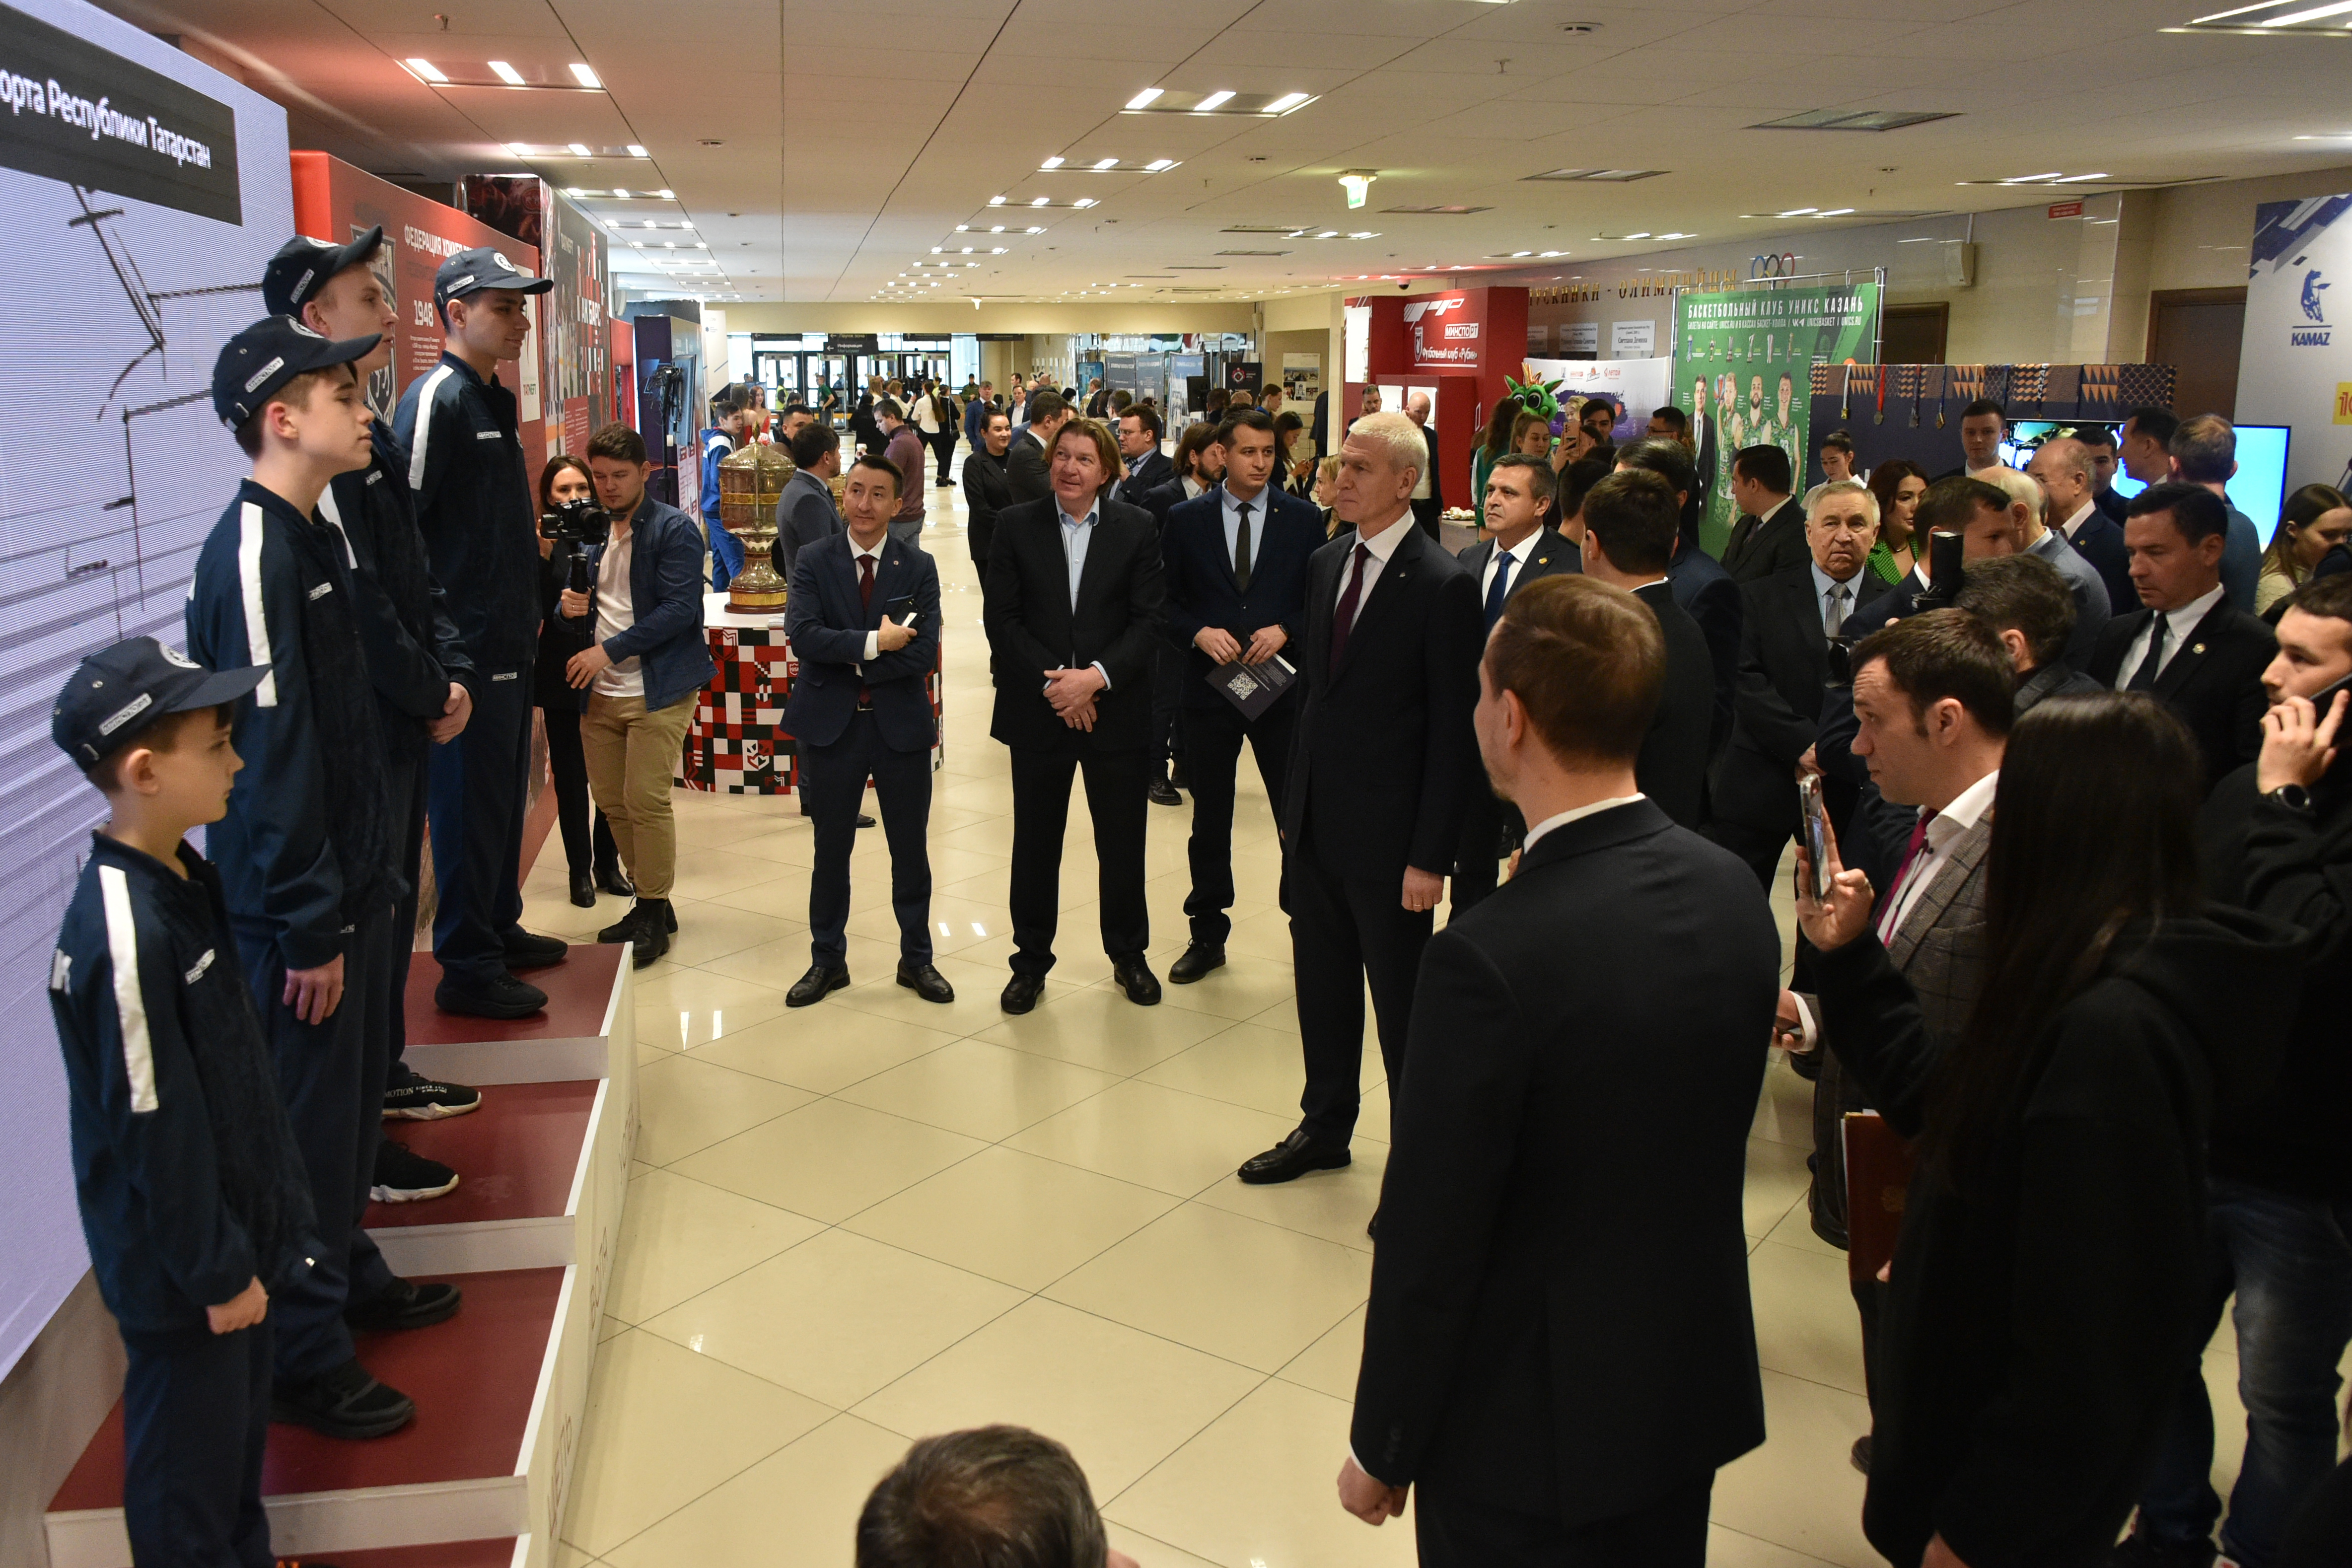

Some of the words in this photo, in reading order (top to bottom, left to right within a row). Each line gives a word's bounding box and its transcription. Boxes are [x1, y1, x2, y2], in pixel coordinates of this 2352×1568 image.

[47, 77, 148, 148] Республики
[147, 115, 212, 169] Татарстан
[404, 224, 442, 257] ФЕДЕРАЦИЯ
[1619, 268, 1736, 298] ОЛИМПИЙЦЫ
[414, 300, 434, 327] 1948
[1688, 299, 1757, 318] БАСКЕТБОЛЬНЫЙ
[1761, 300, 1783, 316] КЛУБ
[1788, 299, 1819, 314] УНИКС
[1824, 296, 1863, 313] КАЗАНЬ
[1445, 326, 1478, 337] МИНСПОРТ
[1841, 316, 1861, 326] UNICS.RU
[2291, 332, 2331, 346] KAMAZ
[1422, 347, 1447, 361] Футбольный
[1447, 347, 1459, 362] клуб
